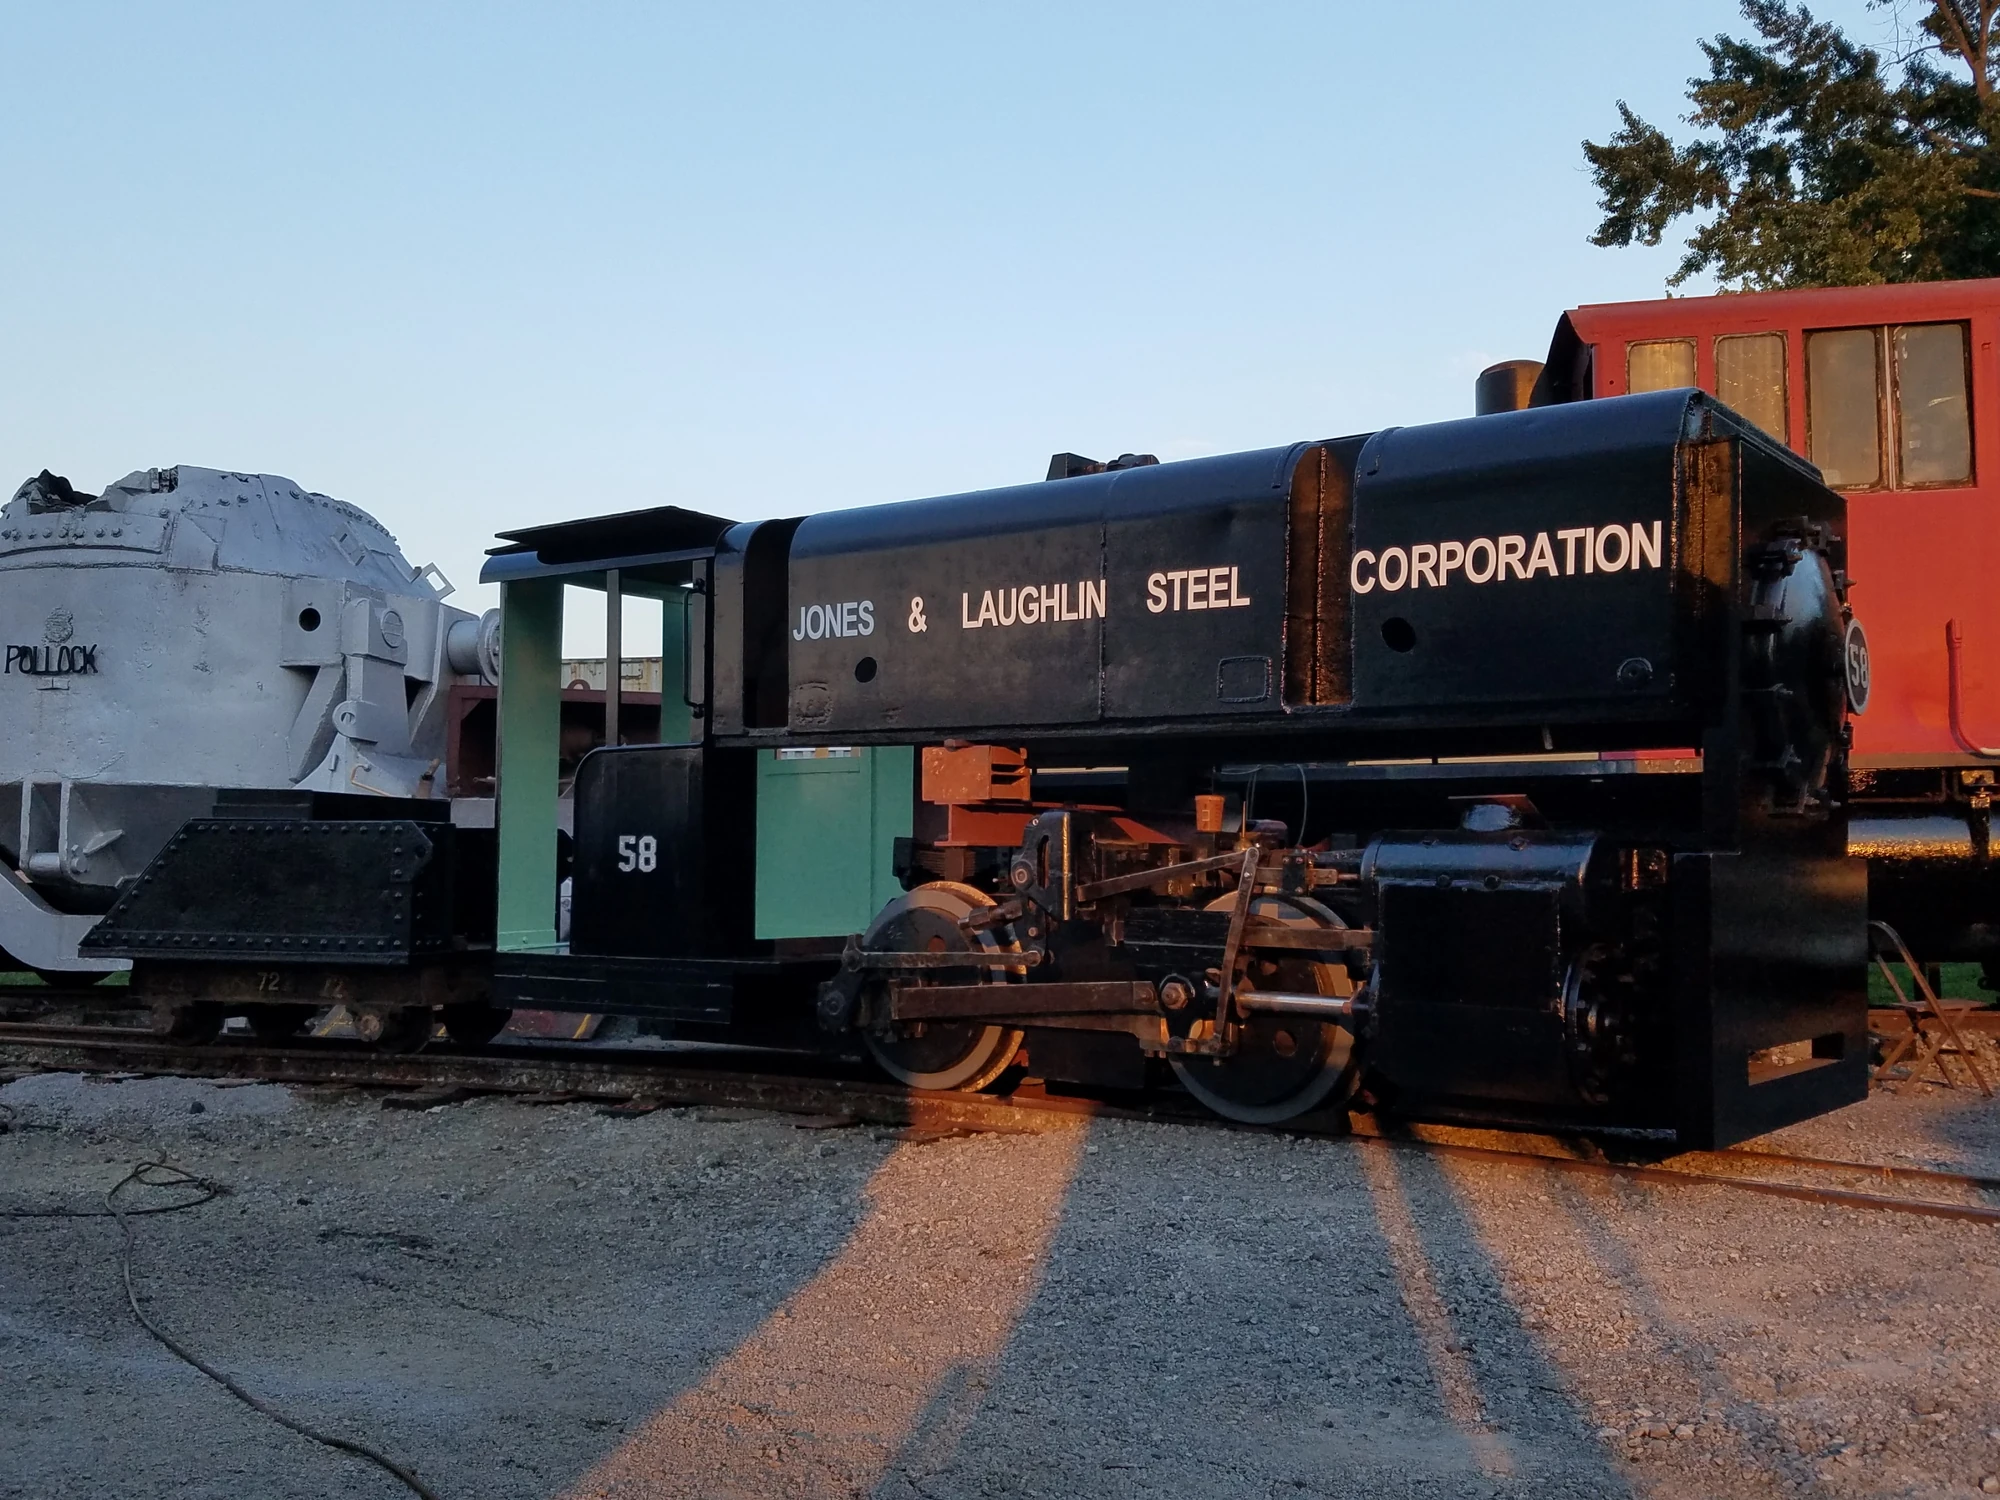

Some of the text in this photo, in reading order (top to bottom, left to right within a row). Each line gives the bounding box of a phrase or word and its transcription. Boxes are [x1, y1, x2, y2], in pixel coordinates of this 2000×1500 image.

[792, 520, 1662, 641] JONES & LAUGHLIN STEEL CORPORATION
[4, 643, 99, 676] POLLOCK
[1849, 643, 1868, 689] 58
[618, 835, 657, 873] 58
[257, 972, 280, 991] 72
